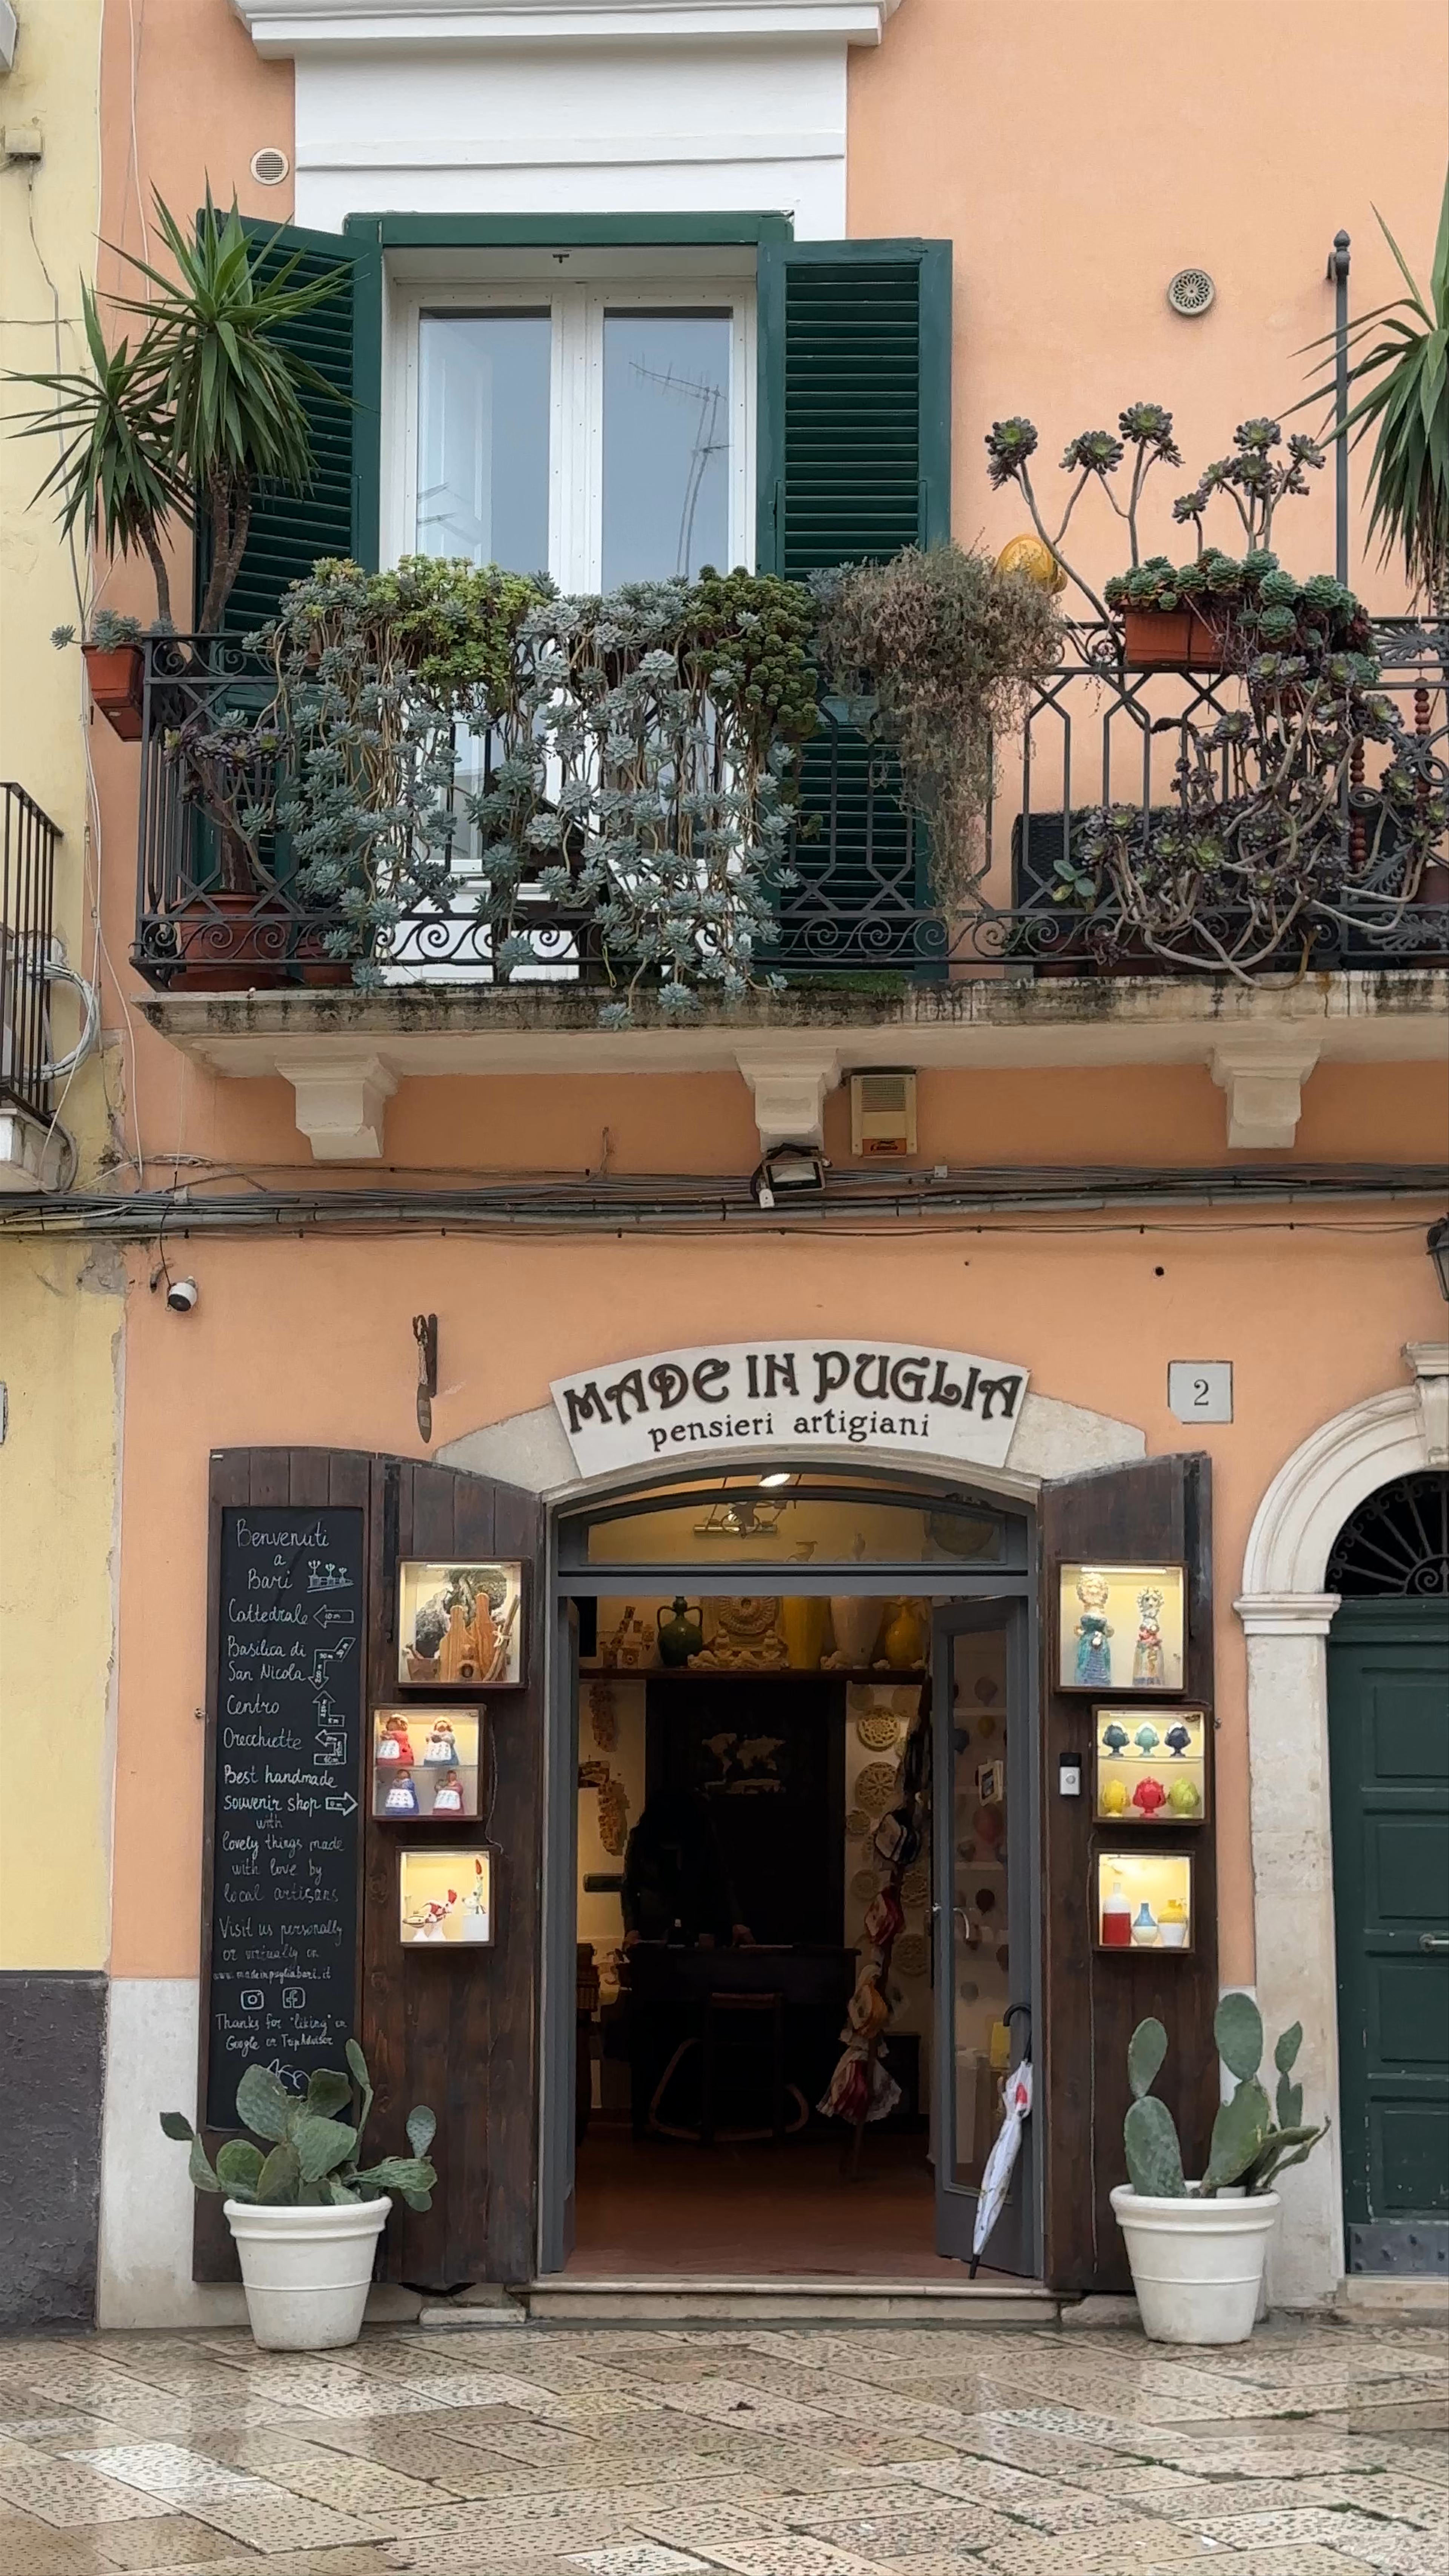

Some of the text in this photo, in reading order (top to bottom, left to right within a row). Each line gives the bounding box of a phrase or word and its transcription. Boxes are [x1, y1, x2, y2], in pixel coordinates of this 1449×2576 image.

[562, 1351, 1023, 1433] MADE IN PUGLIA
[1194, 1379, 1209, 1406] 2
[647, 1409, 930, 1452] pensieri artigiani
[236, 1518, 329, 1547] Benvenuti
[274, 1554, 286, 1566] a
[248, 1568, 293, 1590] Bari
[229, 1598, 308, 1625] Cattedrale
[228, 1635, 306, 1657] Basilica di
[228, 1660, 306, 1681] San Nicola
[226, 1693, 280, 1715] Centro
[223, 1726, 303, 1750] Orecchiette
[224, 1764, 338, 1788] Best handmade
[287, 1792, 322, 1818] shop
[255, 1813, 284, 1829] with
[265, 1833, 303, 1858] things
[309, 1835, 344, 1851] made
[232, 1858, 323, 1885] with love by
[224, 1883, 339, 1903] local artisans
[218, 1916, 343, 1947] Visit us personally
[222, 1948, 238, 1961] or
[215, 2013, 259, 2031] Thanks
[266, 2013, 282, 2029] for
[226, 2035, 260, 2057] Google
